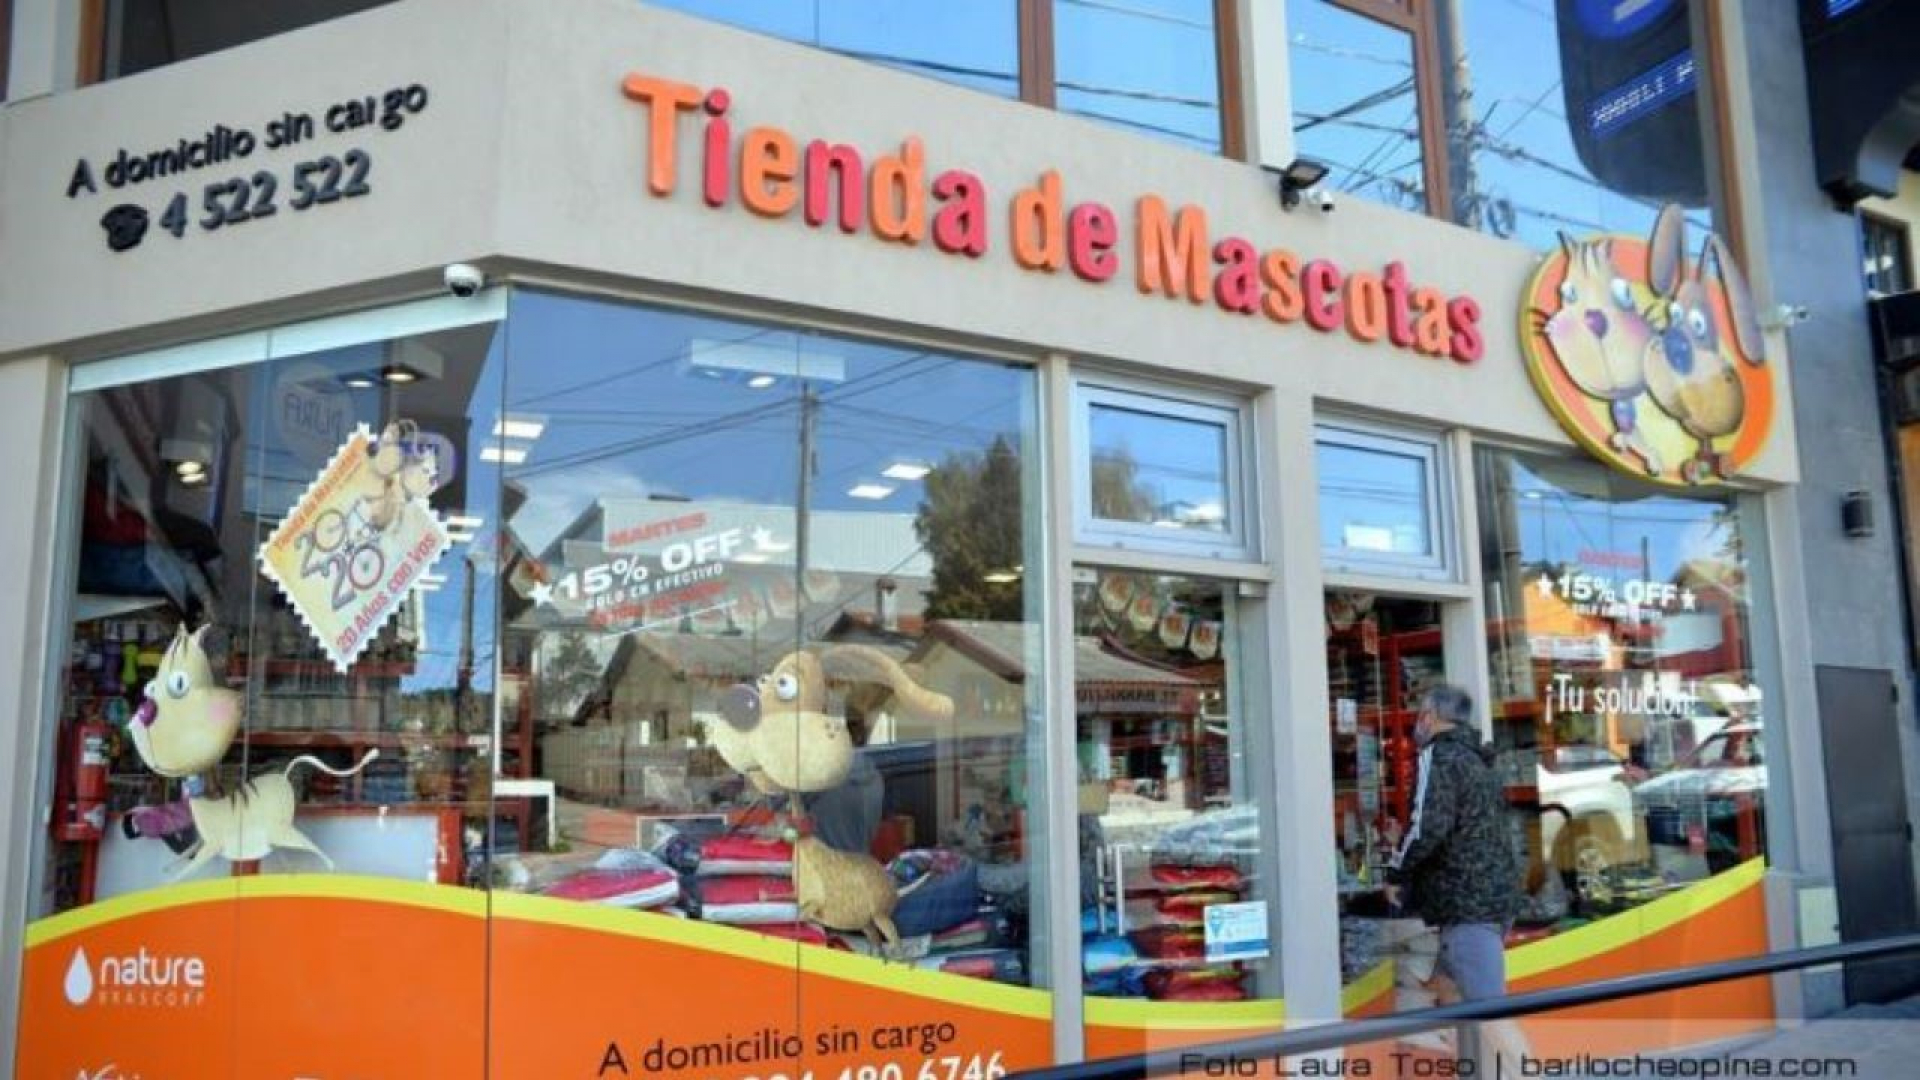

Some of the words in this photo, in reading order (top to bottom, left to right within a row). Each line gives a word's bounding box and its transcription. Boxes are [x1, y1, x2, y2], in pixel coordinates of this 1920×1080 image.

[66, 158, 97, 198] A
[104, 124, 256, 188] domicilio
[265, 112, 314, 150] sin
[325, 83, 428, 131] cargo
[158, 191, 188, 239] 4
[199, 170, 279, 231] 522
[290, 148, 371, 211] 522
[621, 72, 988, 258] Tienda
[1010, 170, 1118, 281] de
[1135, 193, 1483, 363] Mascotas
[556, 555, 648, 599] 15%
[660, 527, 745, 572] OFF
[1558, 574, 1615, 602] 15%
[1624, 579, 1678, 609] OFF
[1545, 673, 1584, 724] ¡Tu
[100, 947, 205, 985] nature
[598, 1042, 628, 1077] A
[643, 1028, 803, 1073] domicilio
[816, 1025, 858, 1056] sin
[871, 1021, 956, 1054] cargo
